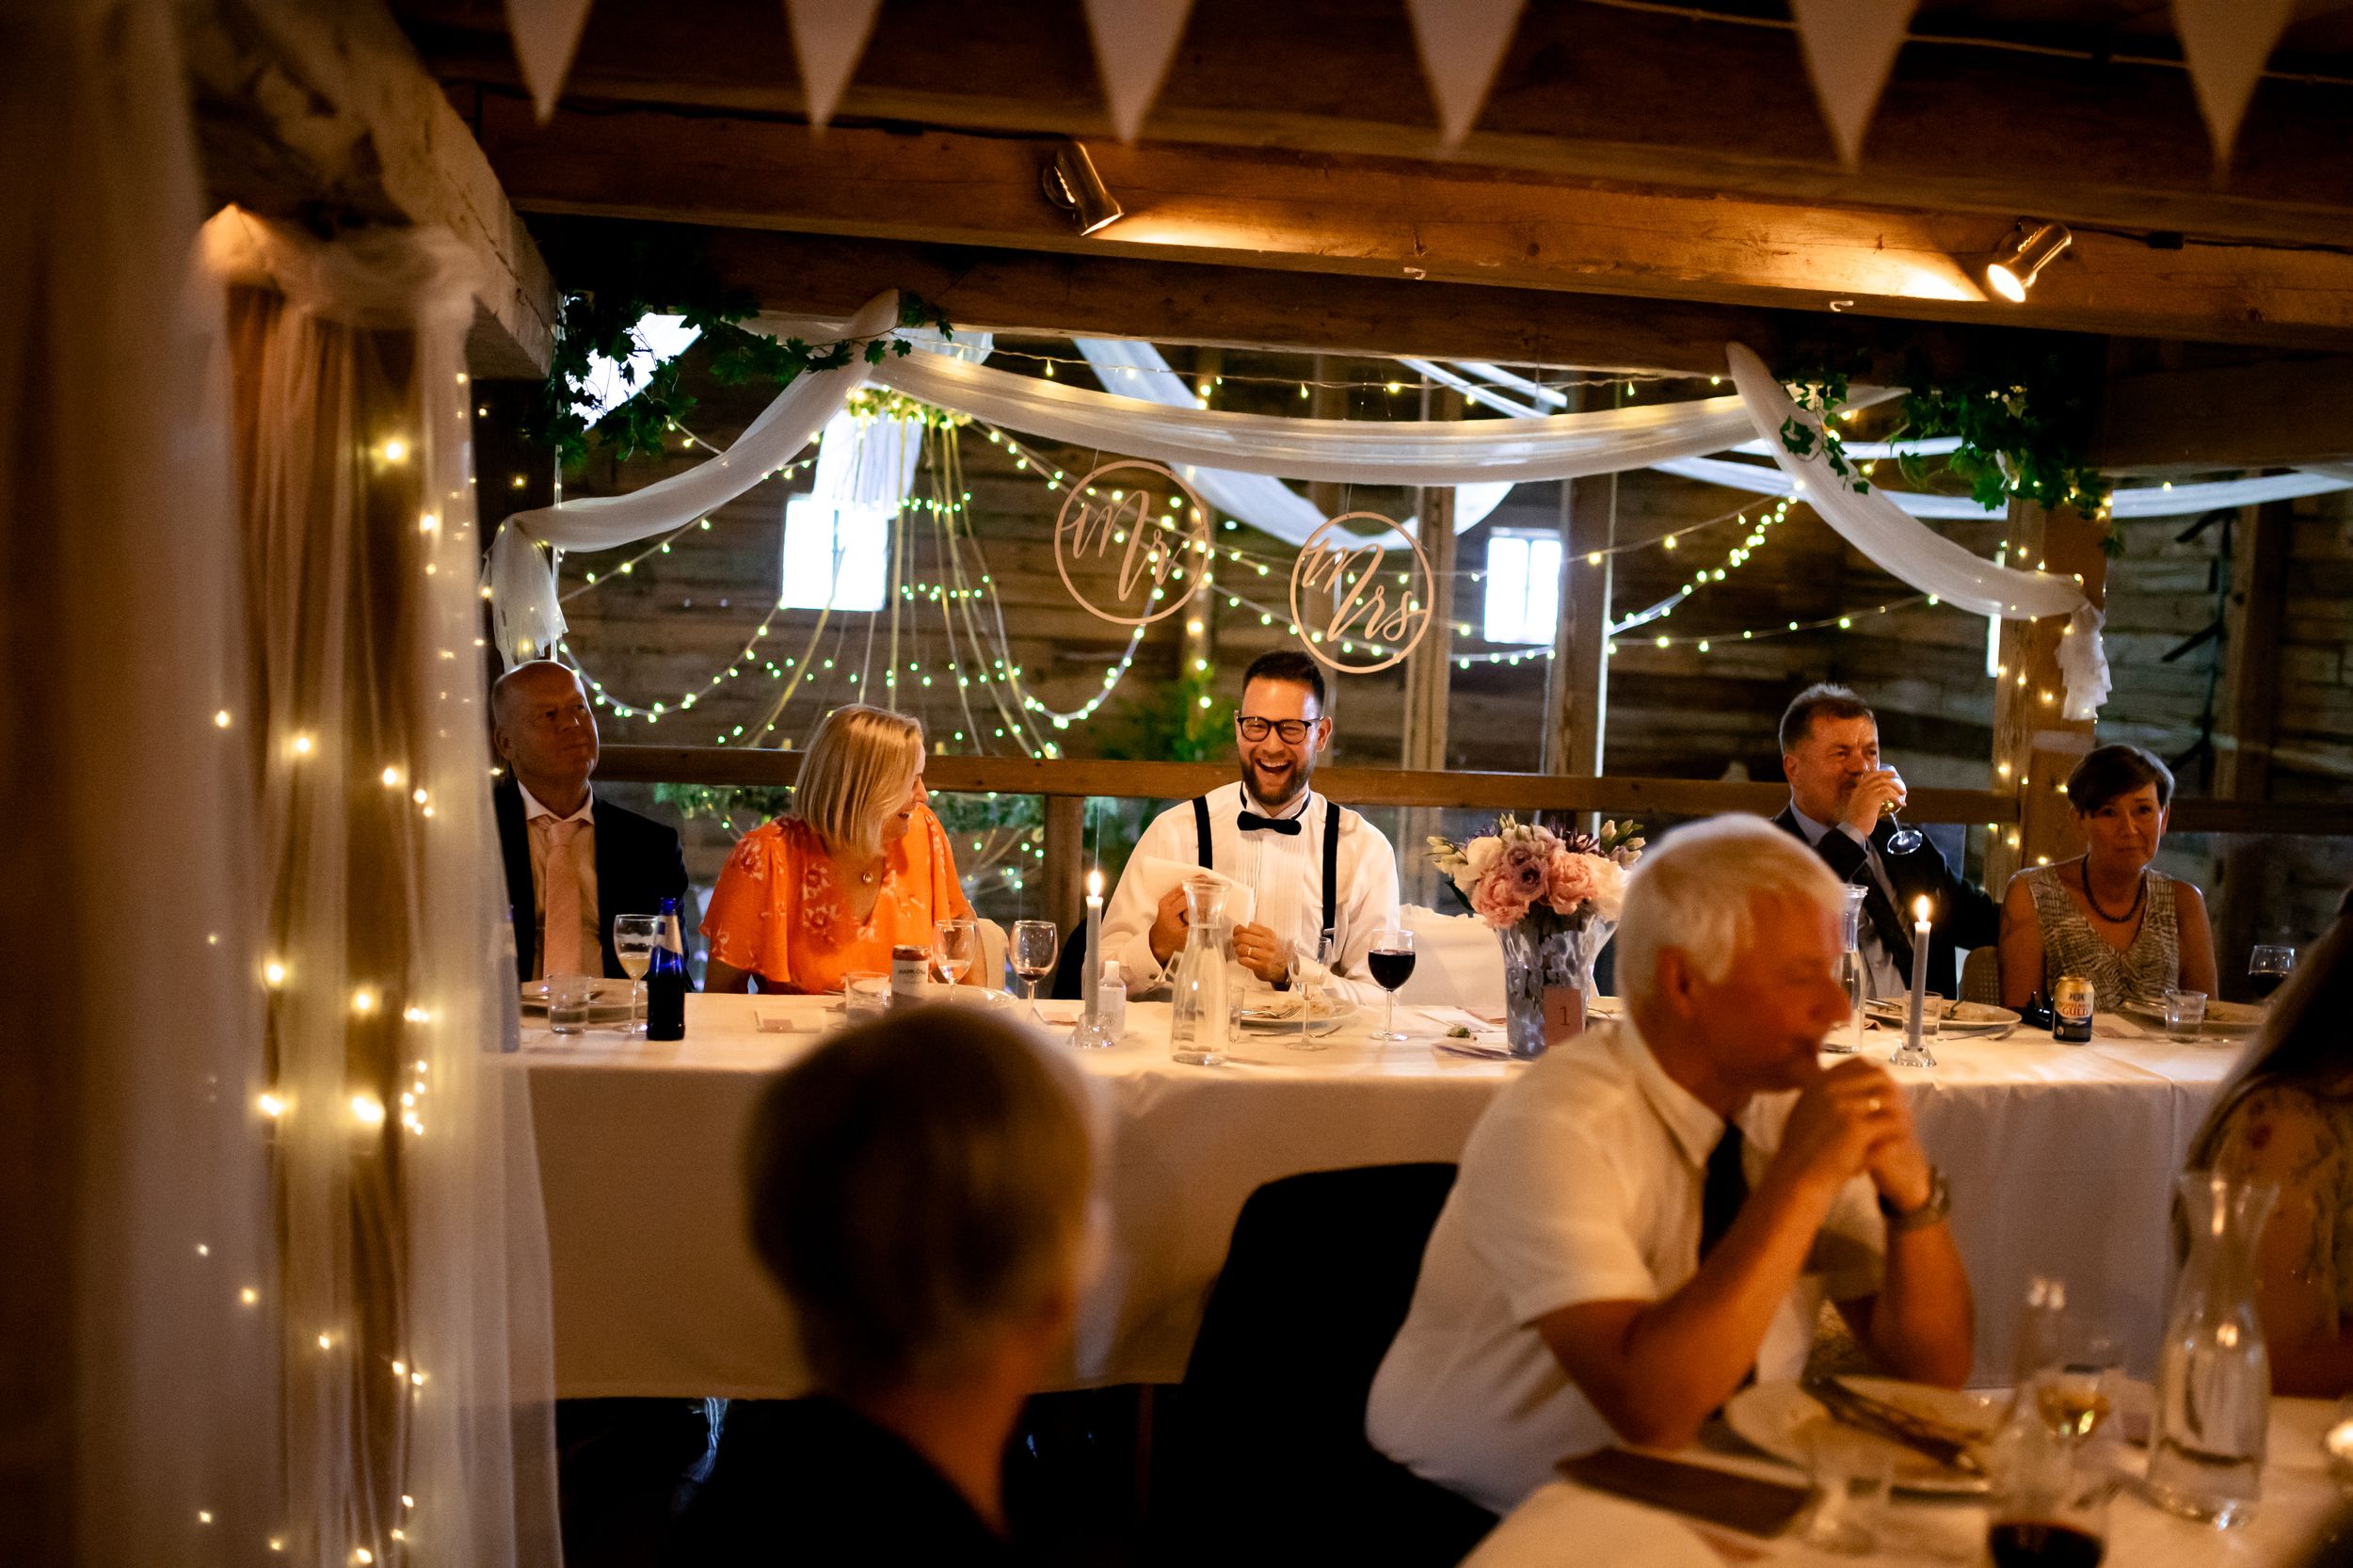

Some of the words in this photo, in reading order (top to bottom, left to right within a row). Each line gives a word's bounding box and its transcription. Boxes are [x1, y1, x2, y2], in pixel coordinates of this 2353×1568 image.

[1061, 490, 1205, 600] Mr
[1302, 537, 1429, 642] Mrs
[1560, 1006, 1570, 1026] 1
[2062, 1006, 2088, 1016] GULD
